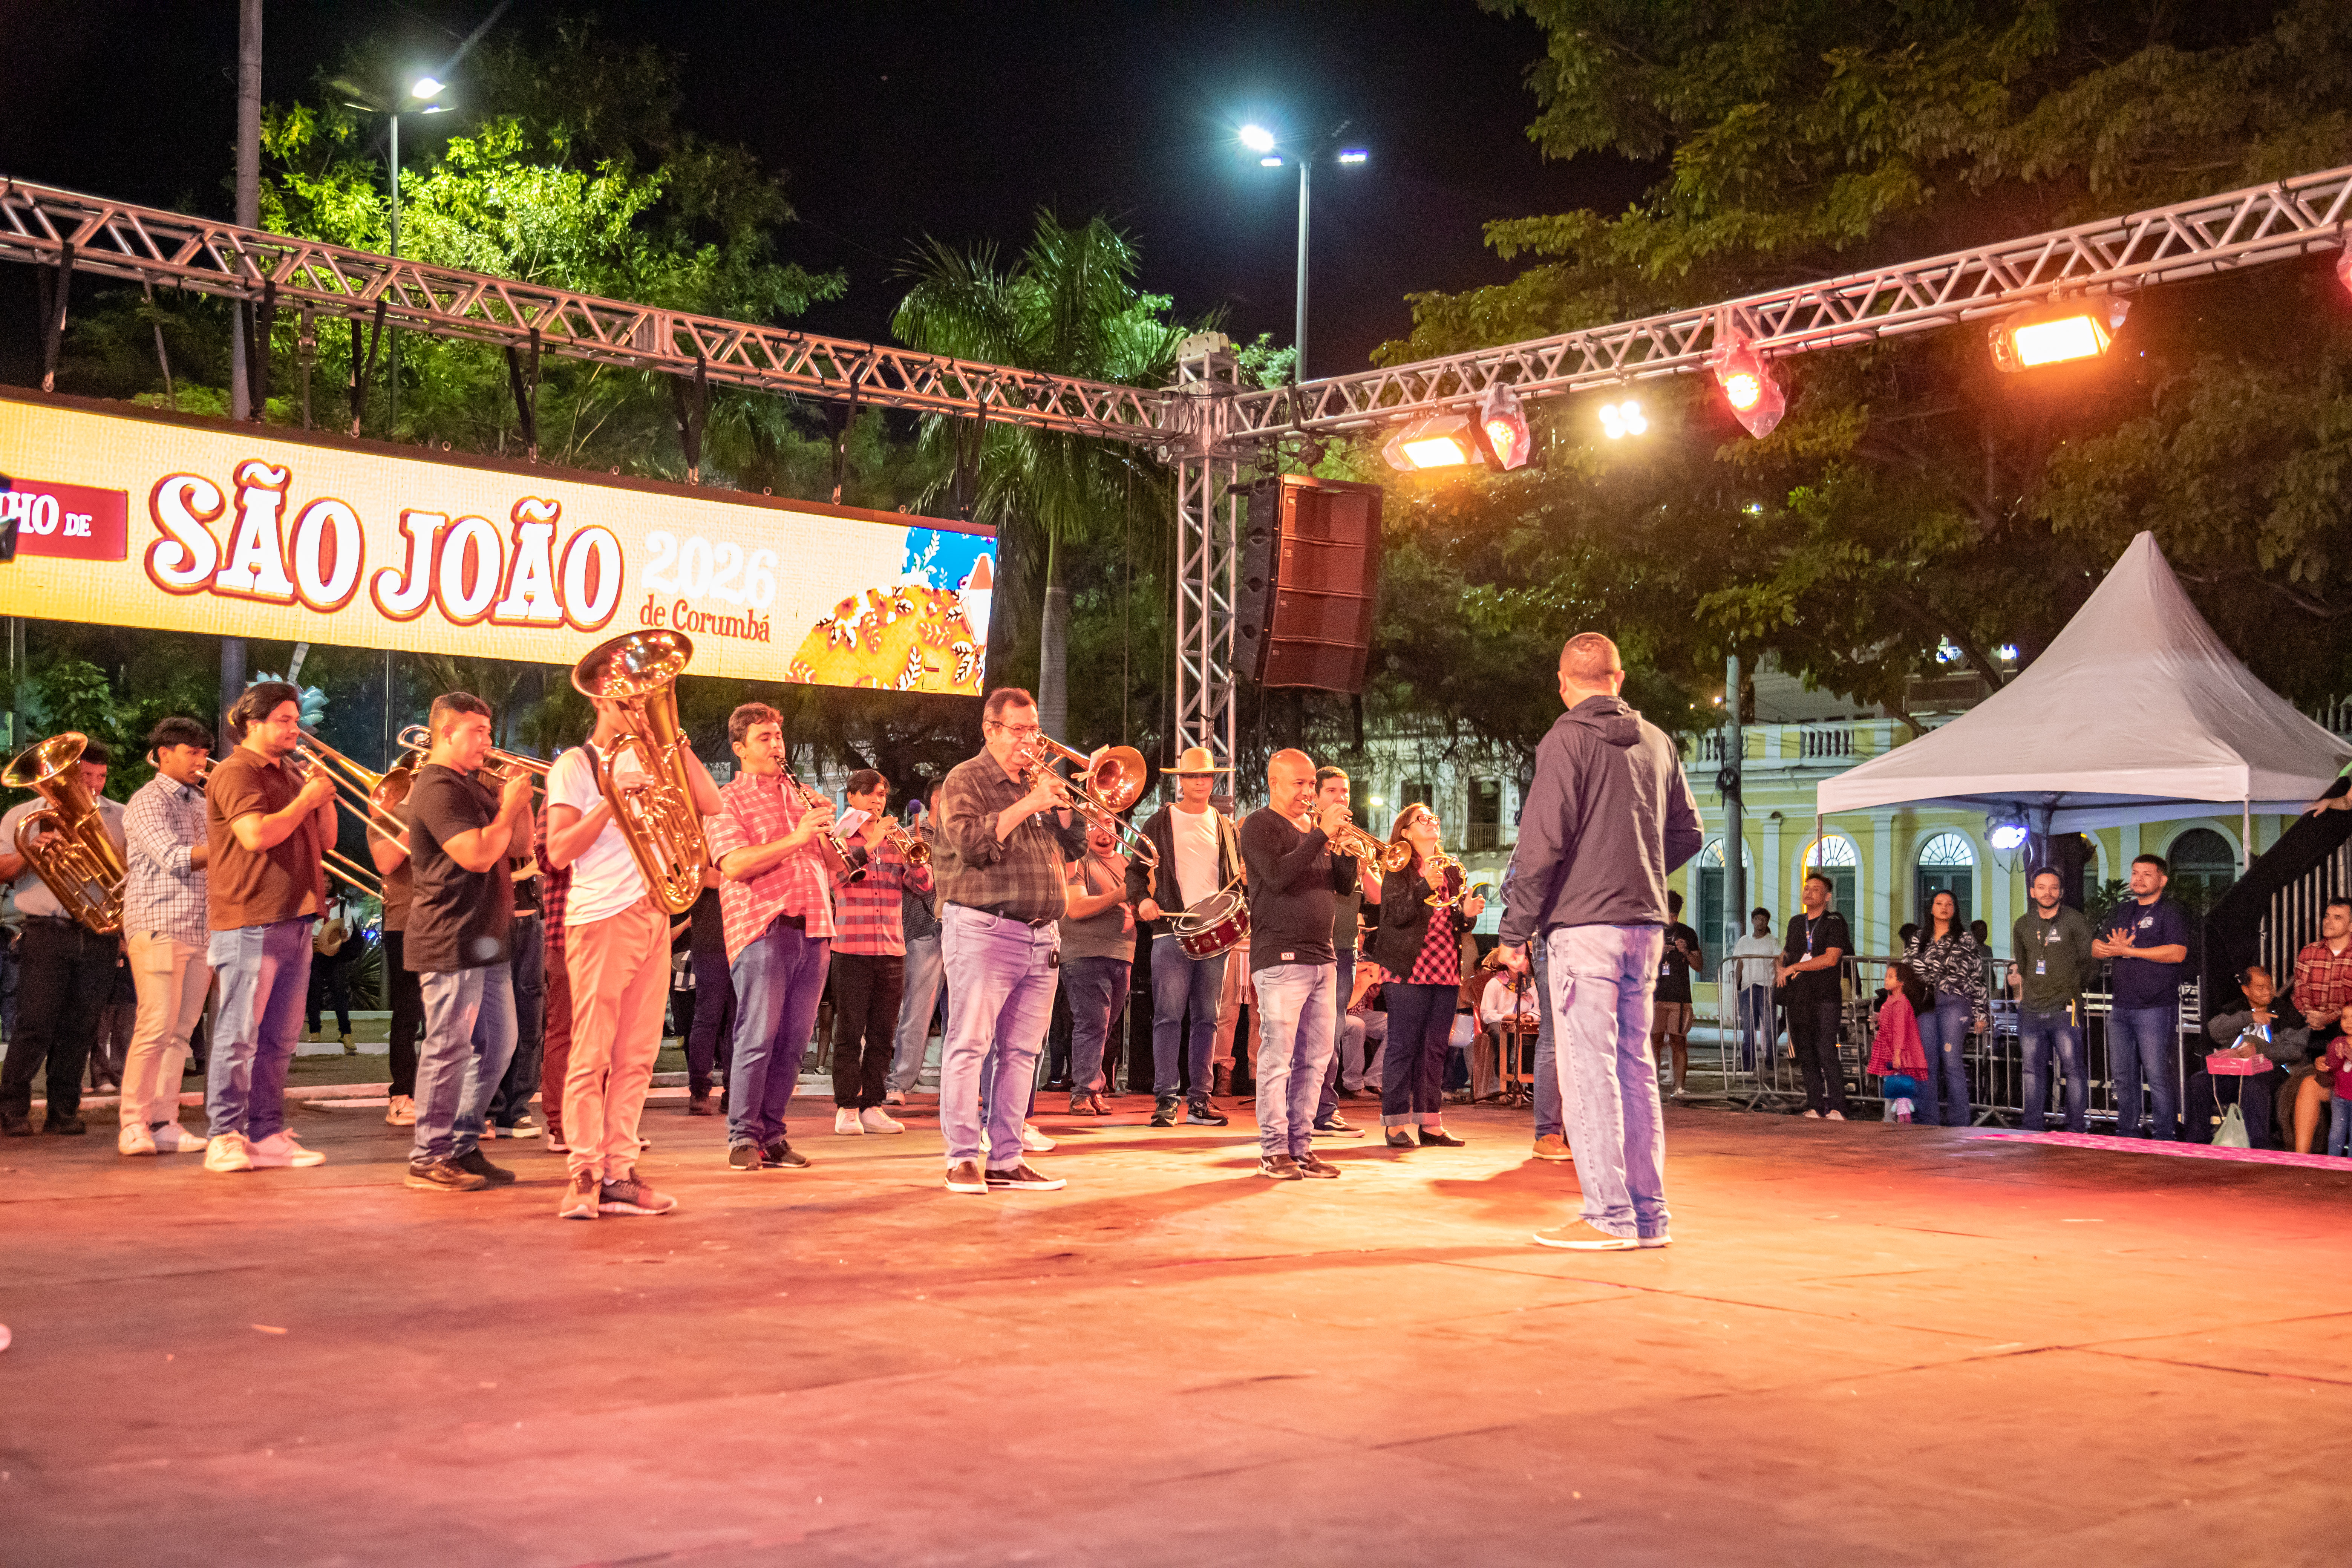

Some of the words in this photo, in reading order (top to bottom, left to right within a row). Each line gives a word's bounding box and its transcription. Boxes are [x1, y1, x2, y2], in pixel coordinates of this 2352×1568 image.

[63, 513, 92, 537] DE
[144, 459, 365, 614] SÃO
[370, 496, 624, 633] JOÃO
[641, 530, 778, 609] 2026
[640, 594, 666, 626] de
[672, 599, 770, 642] Corumbá
